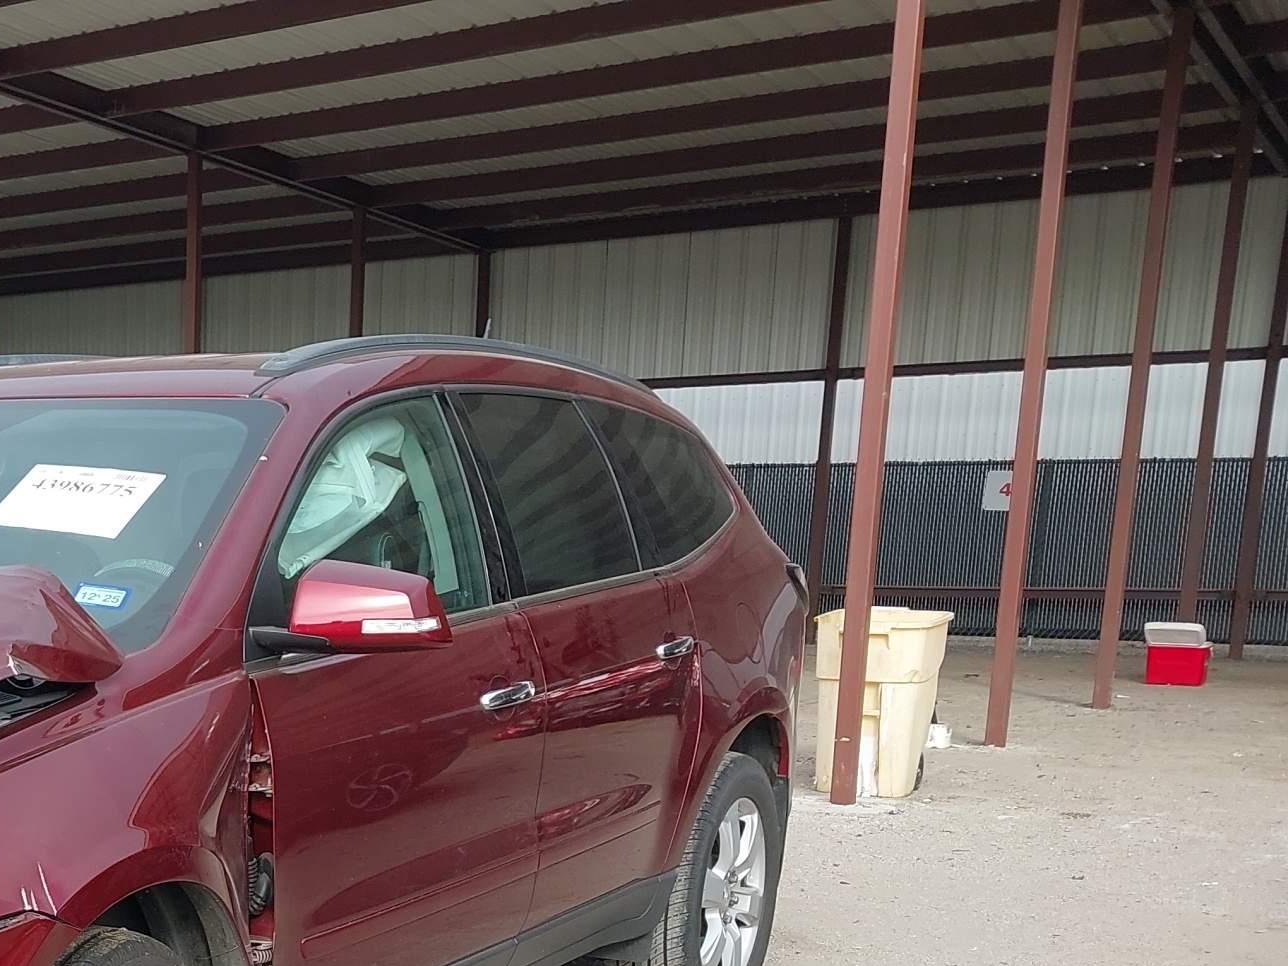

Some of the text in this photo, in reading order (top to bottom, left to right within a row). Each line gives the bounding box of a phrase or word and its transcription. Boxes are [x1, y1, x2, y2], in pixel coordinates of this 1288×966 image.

[31, 478, 137, 497] 43986775
[999, 482, 1013, 497] 4
[102, 594, 121, 604] 25
